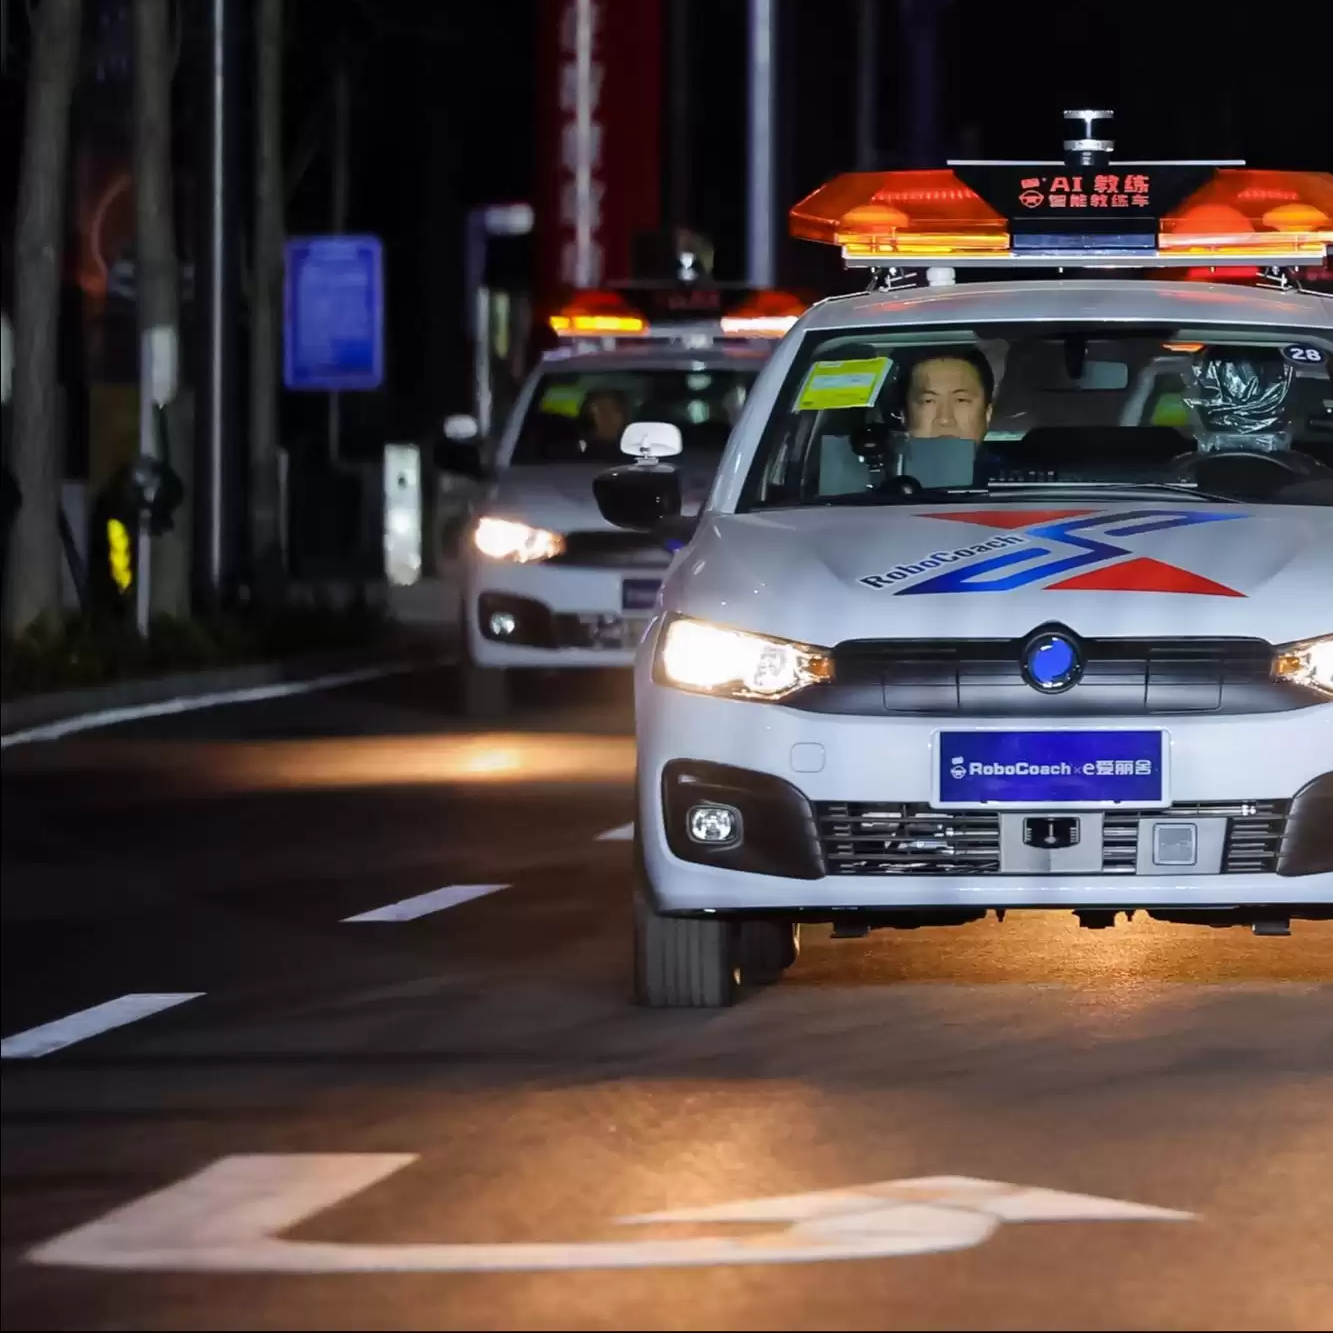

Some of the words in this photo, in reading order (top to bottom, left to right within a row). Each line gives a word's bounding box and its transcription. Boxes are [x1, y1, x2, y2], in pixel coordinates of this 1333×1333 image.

[1049, 176, 1083, 193] AI
[1093, 174, 1150, 194] 教练
[1048, 193, 1150, 208] 智能教练车
[1290, 348, 1321, 361] 28
[860, 533, 1023, 590] RoboCoach
[969, 762, 1072, 776] RoboCoach
